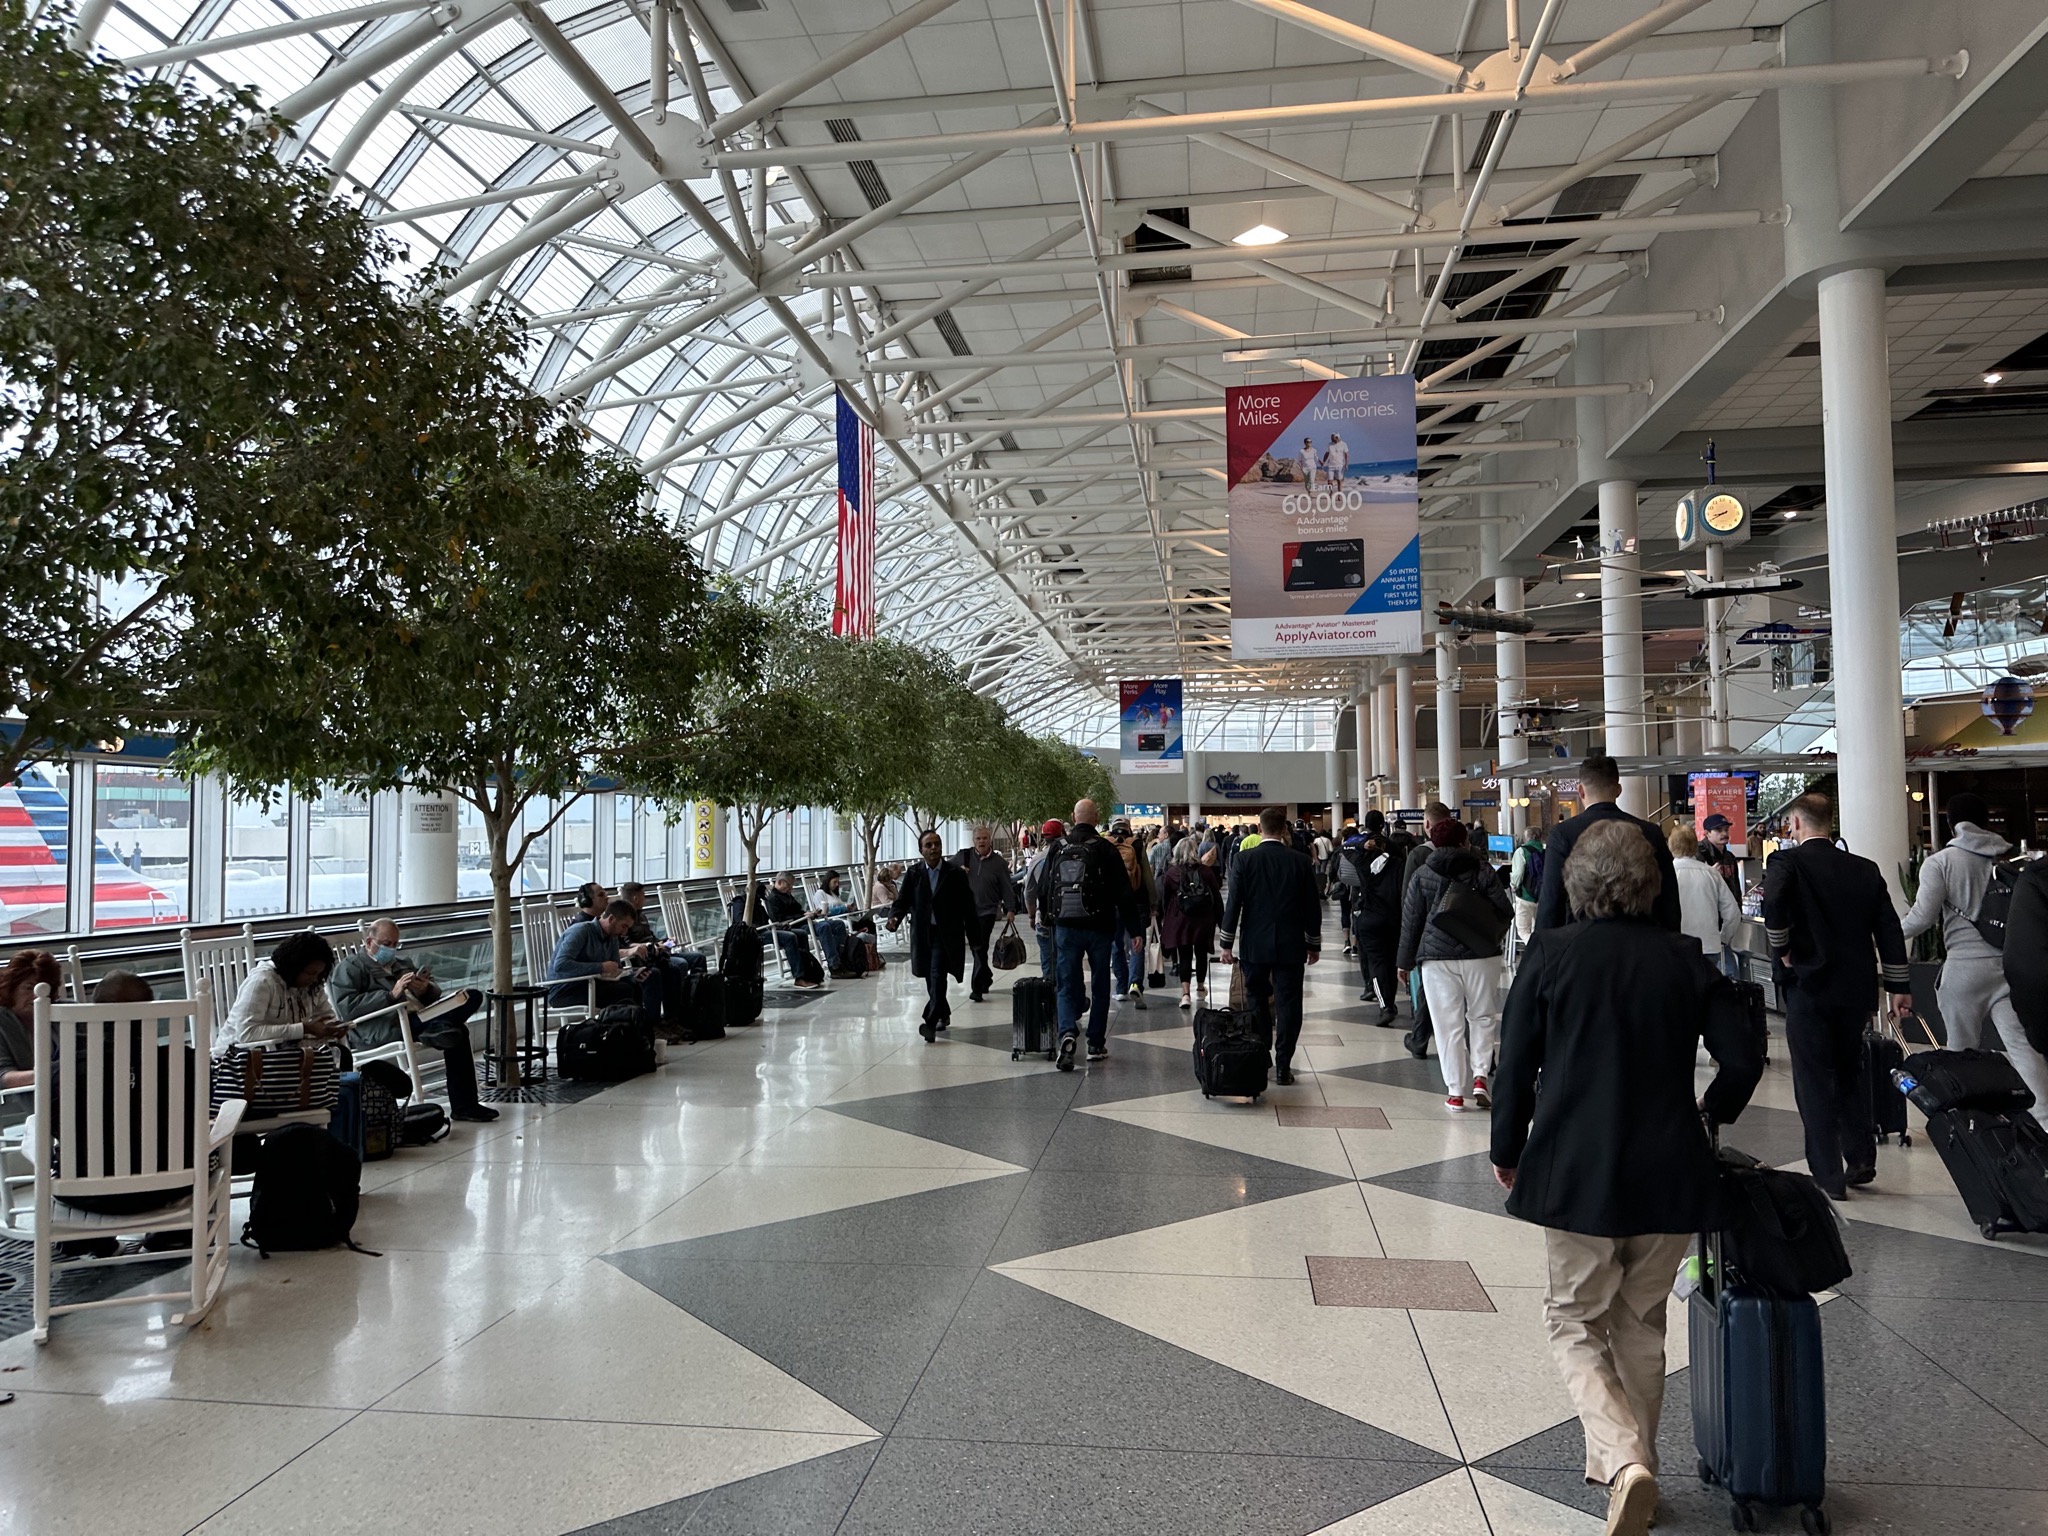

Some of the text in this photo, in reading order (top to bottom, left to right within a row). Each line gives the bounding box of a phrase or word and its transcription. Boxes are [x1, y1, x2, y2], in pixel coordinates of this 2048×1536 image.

[1238, 395, 1280, 410] More
[1327, 389, 1369, 404] More
[1238, 411, 1282, 426] Miles.
[1314, 402, 1398, 421] Memories.
[1311, 483, 1333, 492] Earn
[1282, 490, 1362, 516] 60,000
[1298, 525, 1348, 534] bonus miles
[1275, 630, 1377, 644] ApplyAviator.com
[414, 804, 448, 812] ATTENTION
